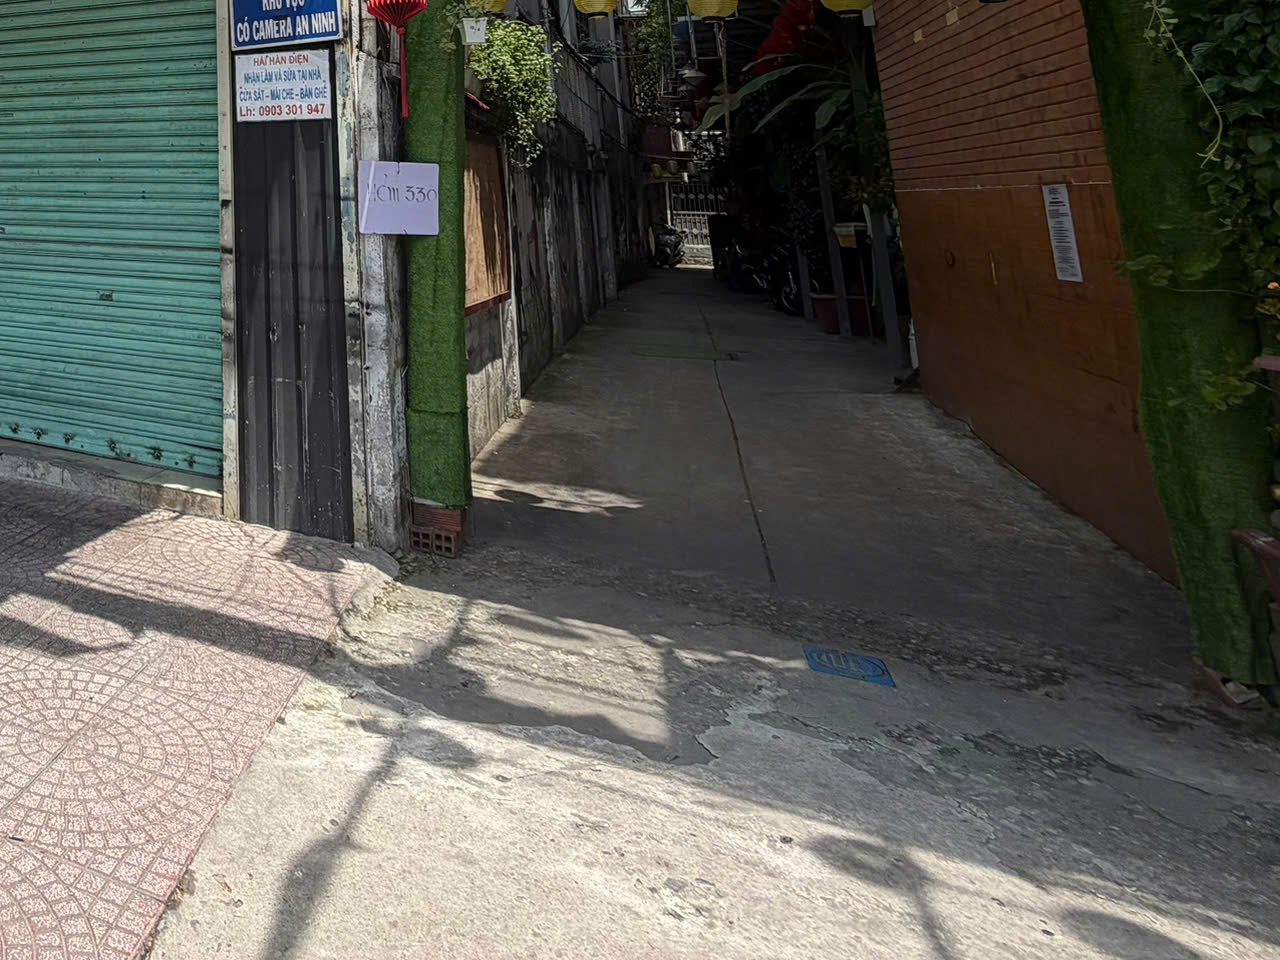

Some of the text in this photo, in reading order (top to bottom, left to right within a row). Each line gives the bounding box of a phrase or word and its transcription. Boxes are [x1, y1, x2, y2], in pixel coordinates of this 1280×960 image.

[237, 11, 336, 42] CÓ CAMERA AN NINH
[269, 54, 287, 65] HÀN
[289, 53, 309, 65] ĐIỆN
[274, 68, 283, 81] VÀ
[308, 66, 322, 80] NHÀ
[281, 88, 295, 100] CHE
[240, 103, 326, 117] Lh: 0903 301 947
[404, 185, 437, 203] 330
